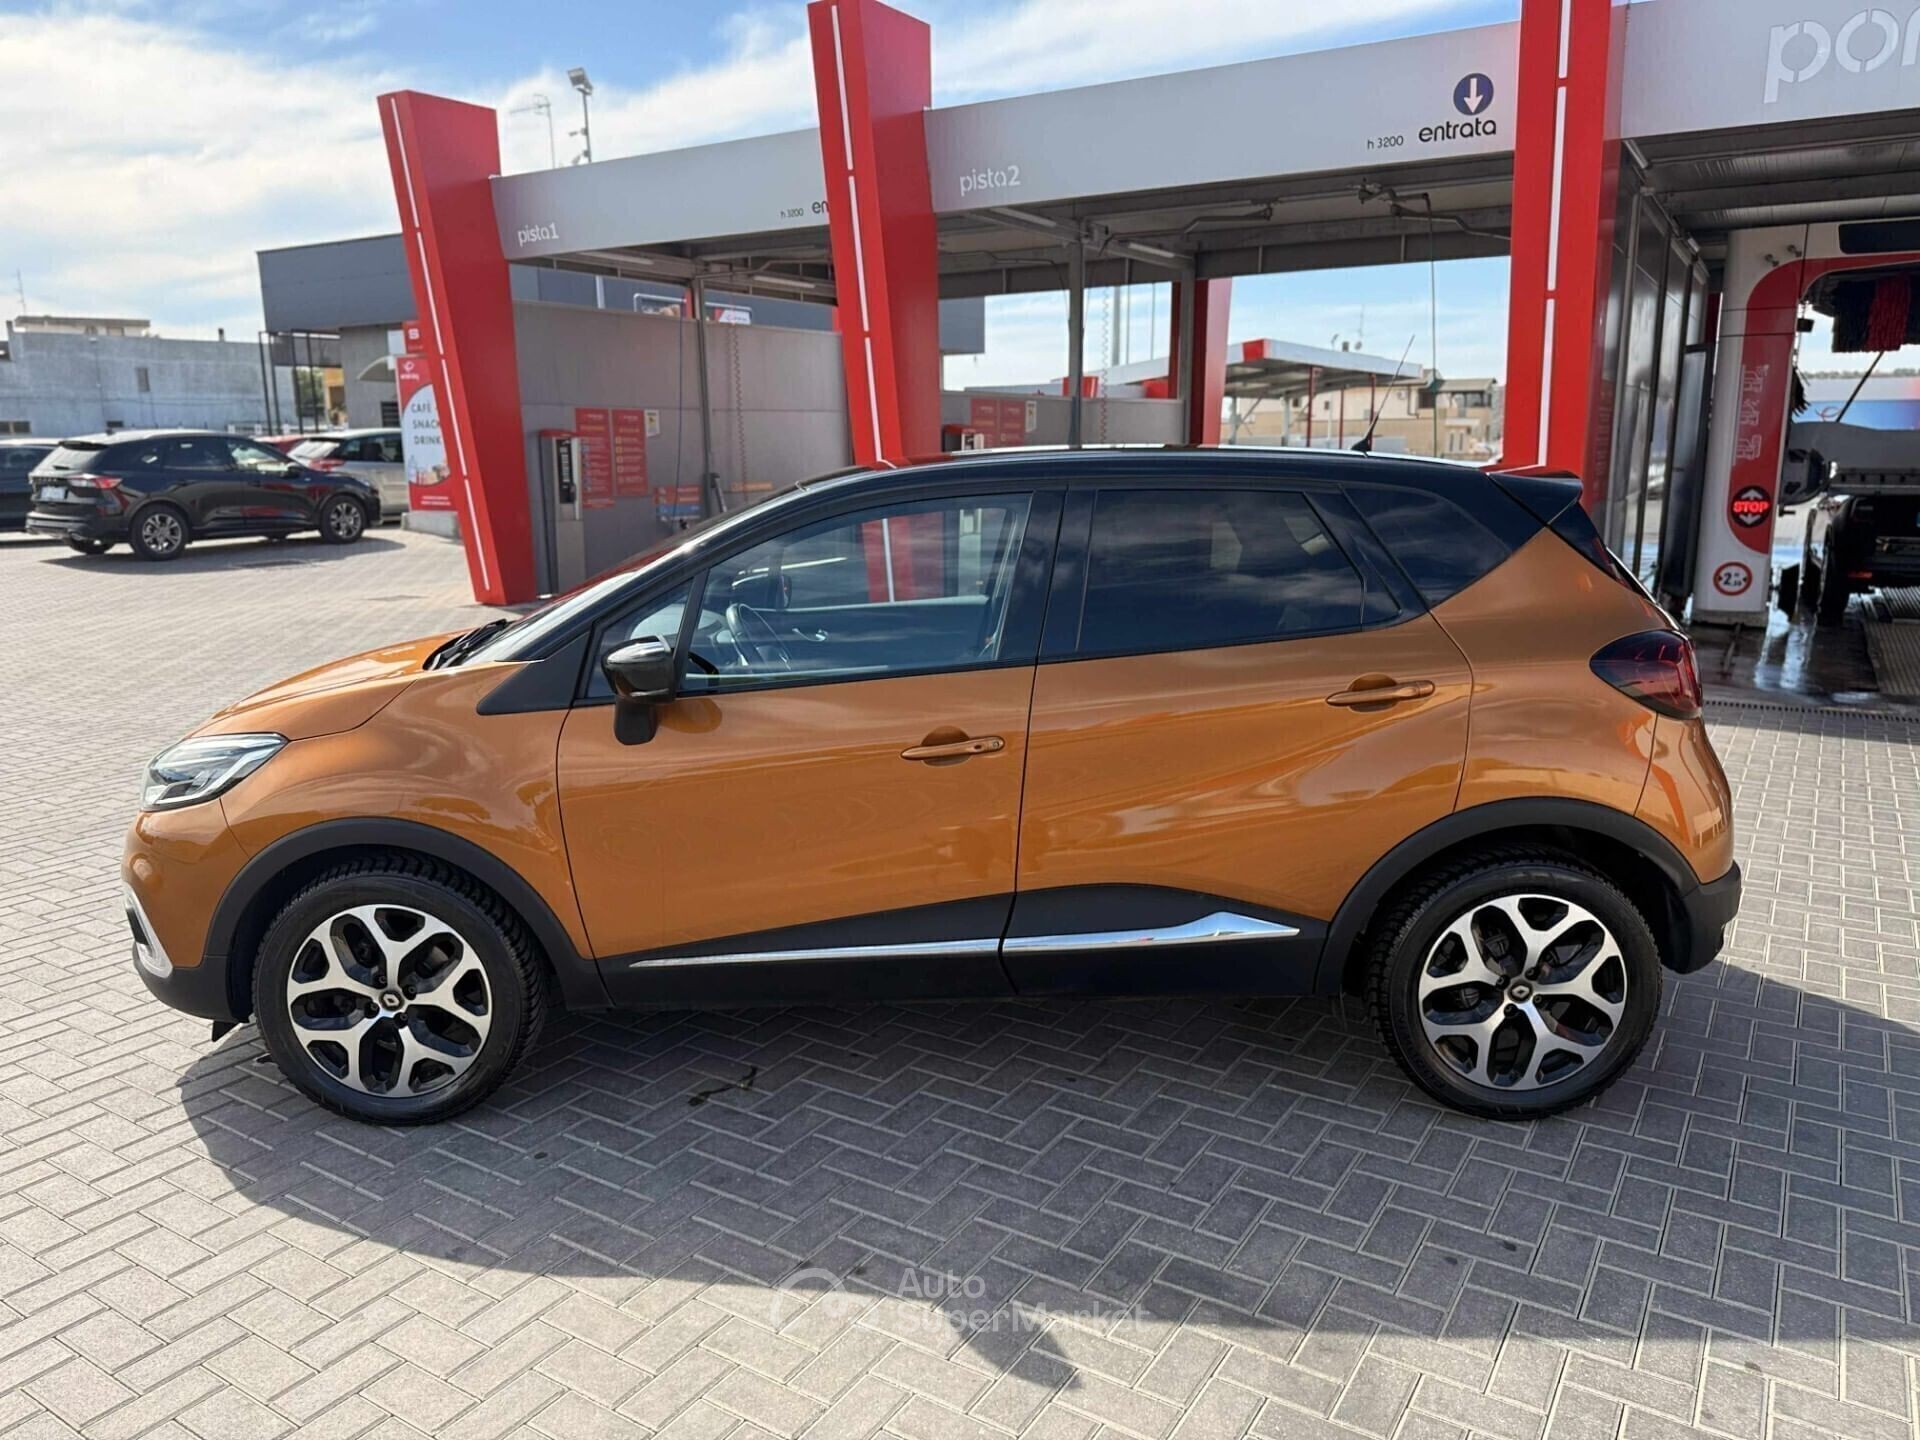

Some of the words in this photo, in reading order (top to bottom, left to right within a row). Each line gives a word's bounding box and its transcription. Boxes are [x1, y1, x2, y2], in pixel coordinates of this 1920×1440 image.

[1367, 139, 1374, 149] h
[1377, 135, 1404, 149] 3200
[1418, 117, 1497, 143] entrata
[959, 165, 1021, 197] pista2
[517, 222, 560, 248] pista1
[1733, 501, 1770, 513] STOP
